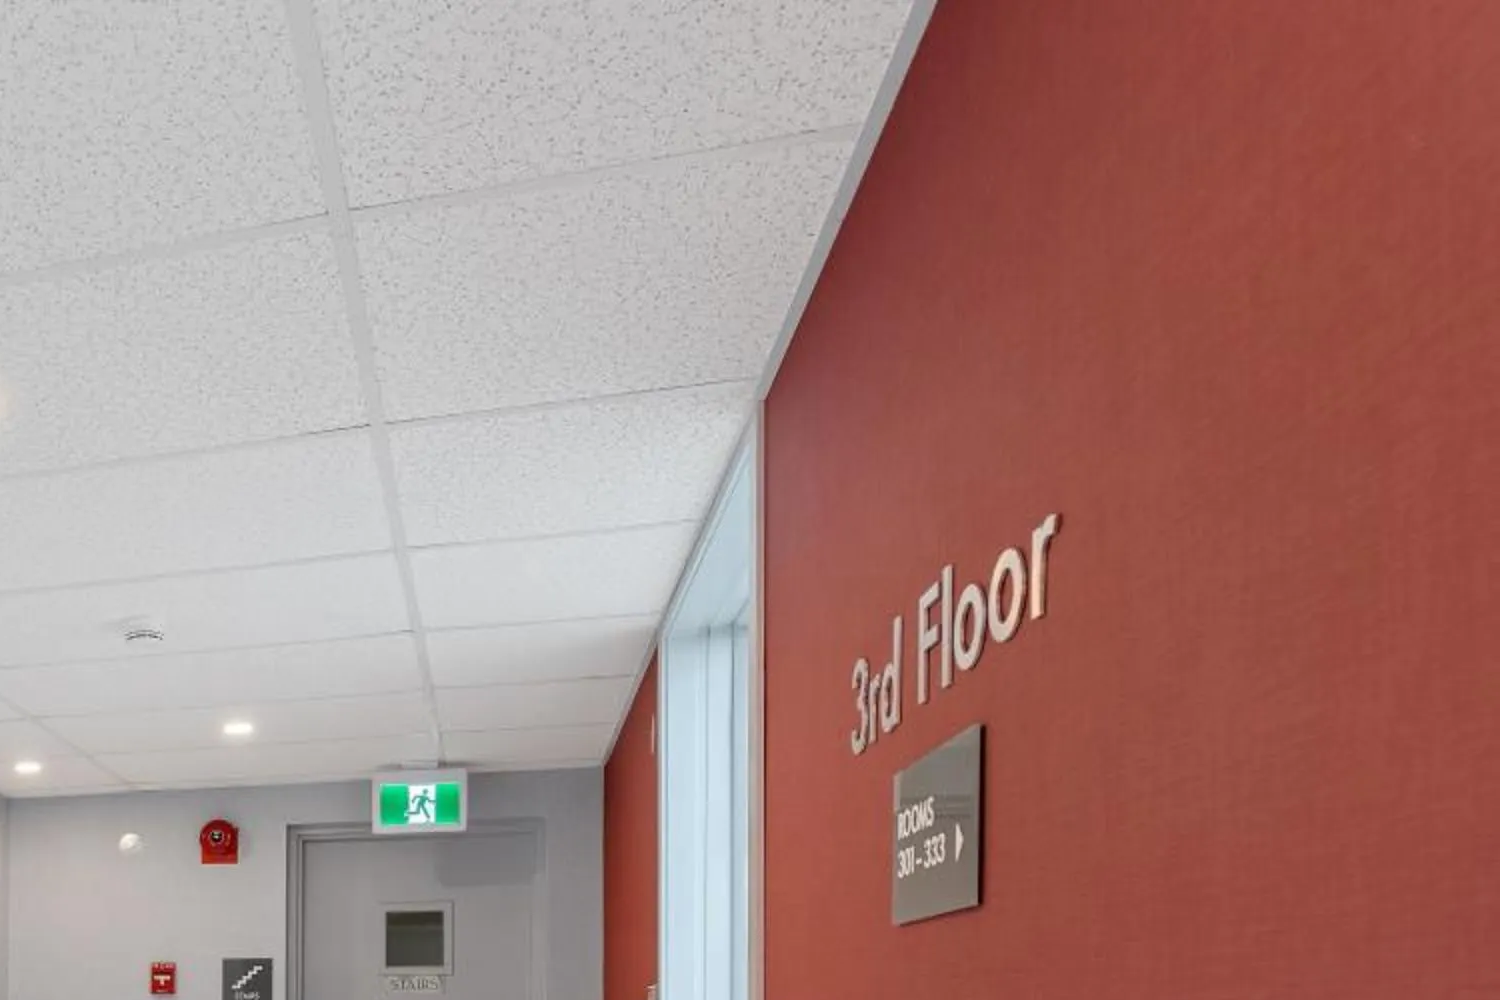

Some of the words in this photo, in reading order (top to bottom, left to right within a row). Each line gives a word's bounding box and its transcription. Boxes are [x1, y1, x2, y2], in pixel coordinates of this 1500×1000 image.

[851, 615, 903, 756] 3rd
[917, 512, 1061, 705] Floor
[897, 796, 935, 841] ROOMS
